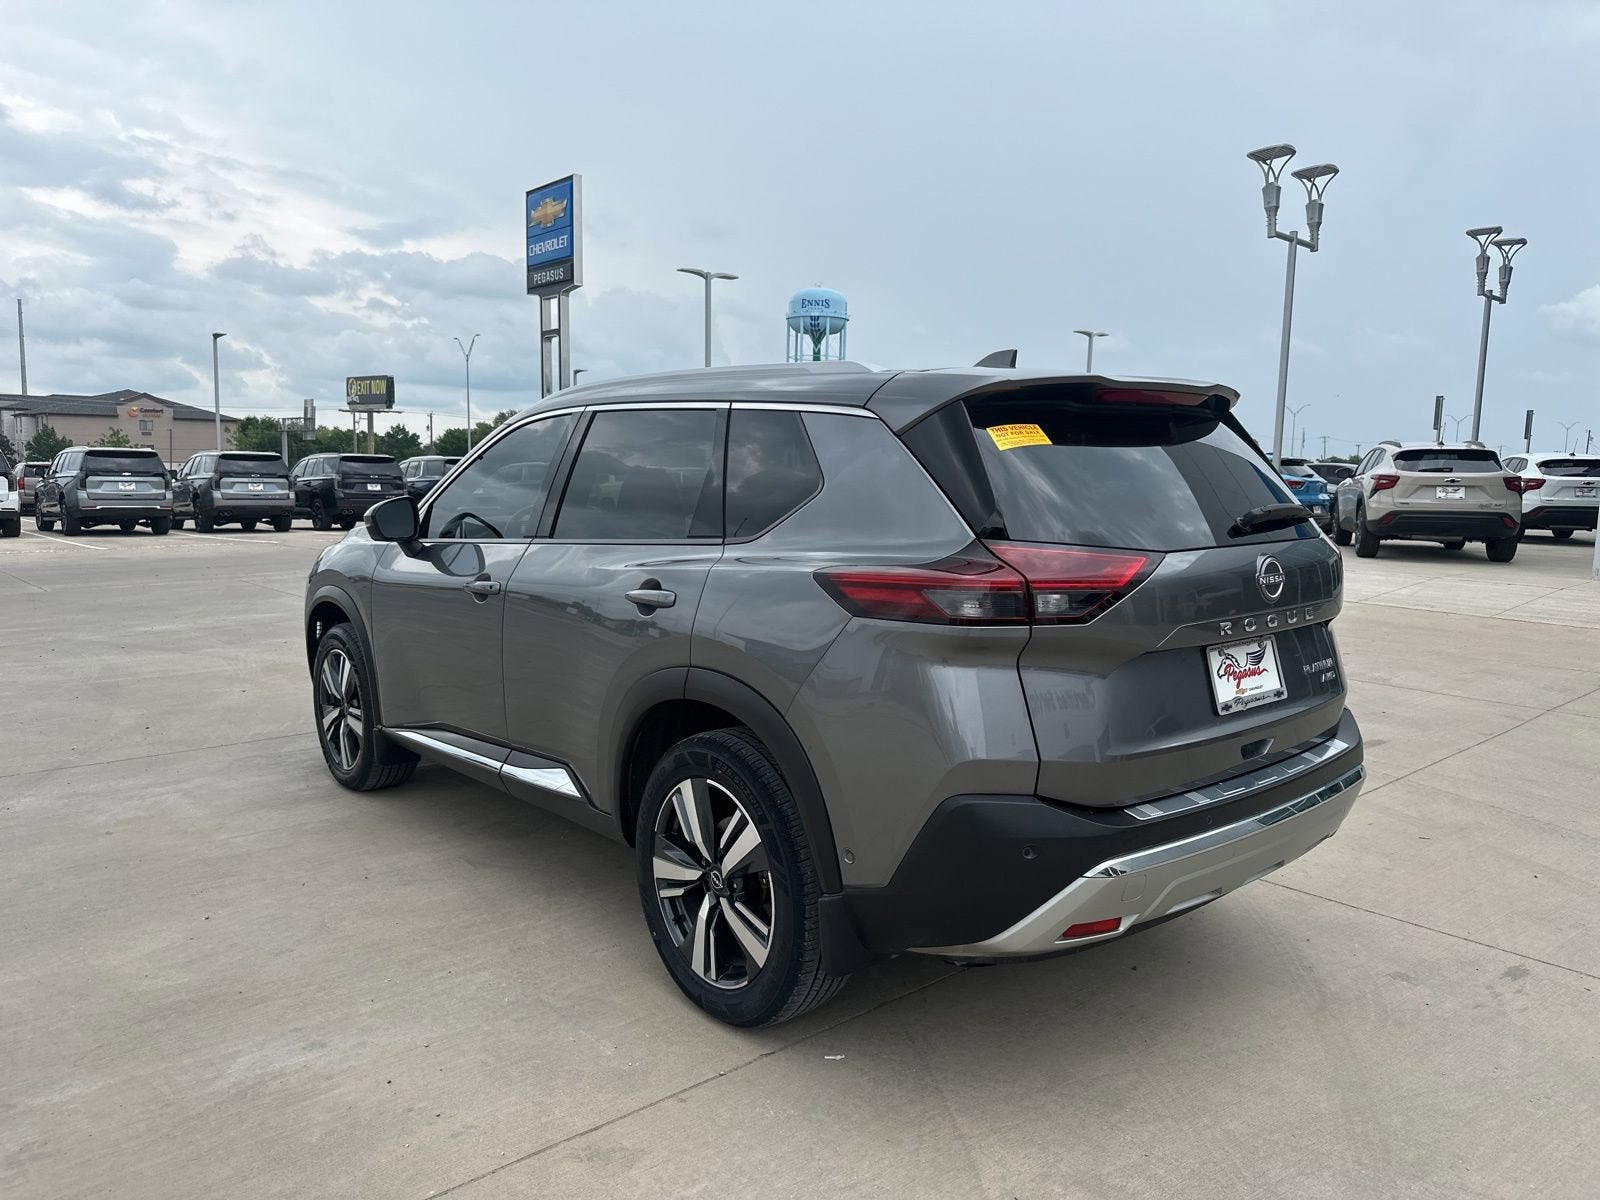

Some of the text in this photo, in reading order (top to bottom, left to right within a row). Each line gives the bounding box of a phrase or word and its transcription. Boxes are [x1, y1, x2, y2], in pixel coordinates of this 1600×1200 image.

[528, 235, 568, 256] CHEVROLET
[533, 268, 564, 285] PEGASUS
[801, 299, 830, 308] ENNIS
[357, 379, 387, 395] EXIT NOW
[1219, 607, 1314, 635] ROGUE
[1224, 663, 1268, 689] Pegasus
